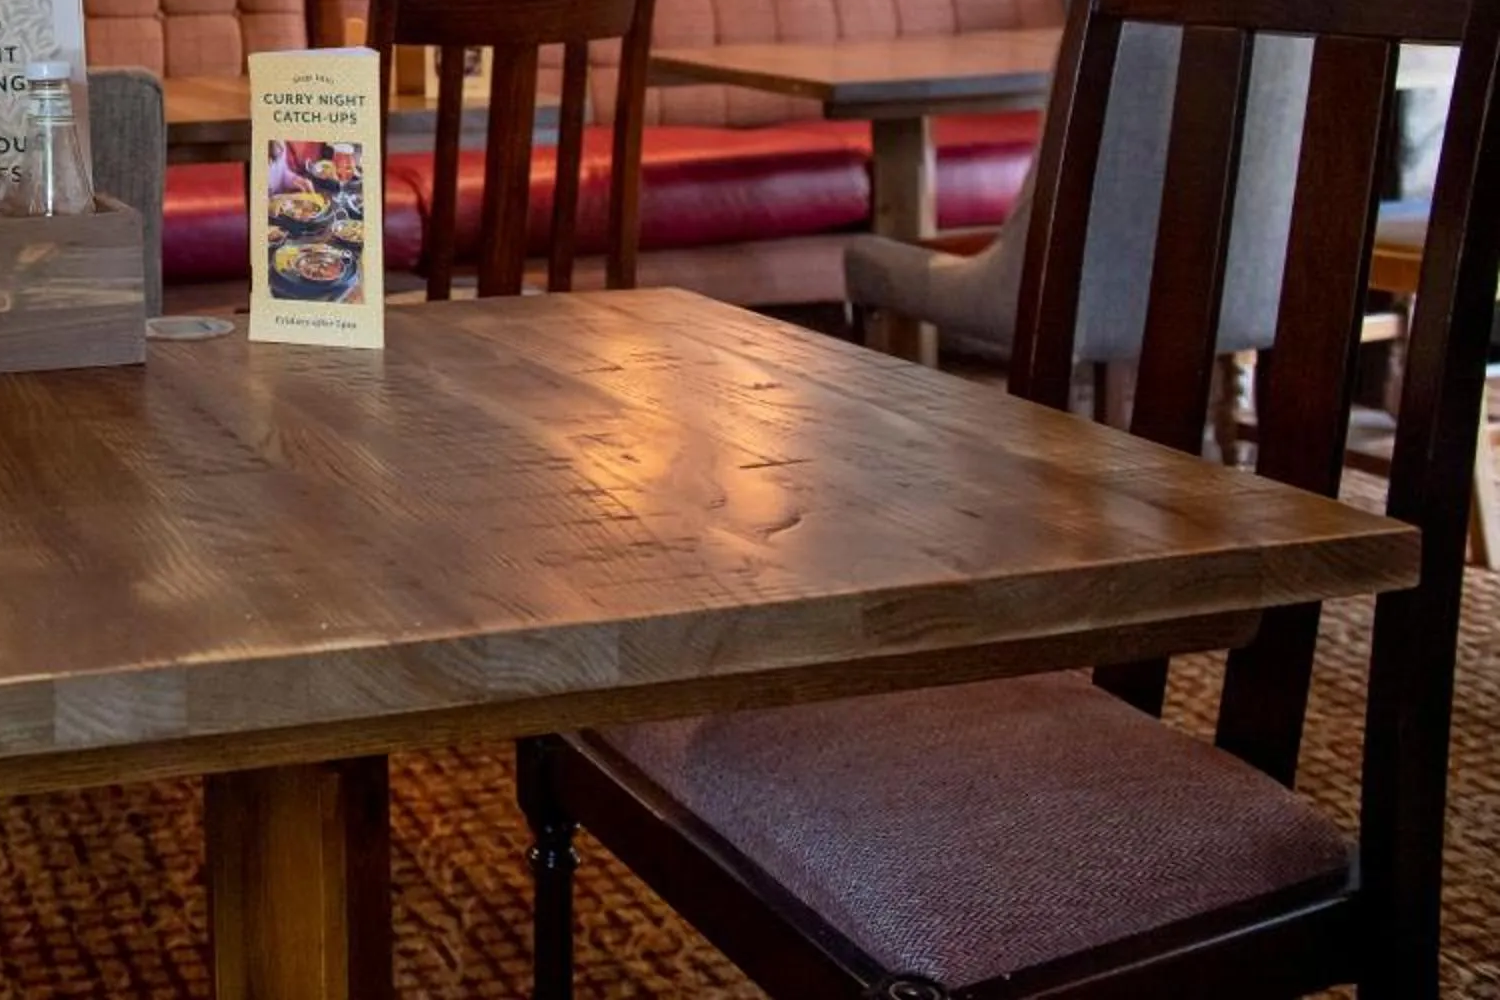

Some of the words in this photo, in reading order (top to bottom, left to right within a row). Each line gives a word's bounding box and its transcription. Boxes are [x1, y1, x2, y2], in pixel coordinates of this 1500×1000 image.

[263, 93, 312, 105] CURRY
[319, 94, 366, 106] NIGHT
[273, 110, 357, 125] CATCH-UPS
